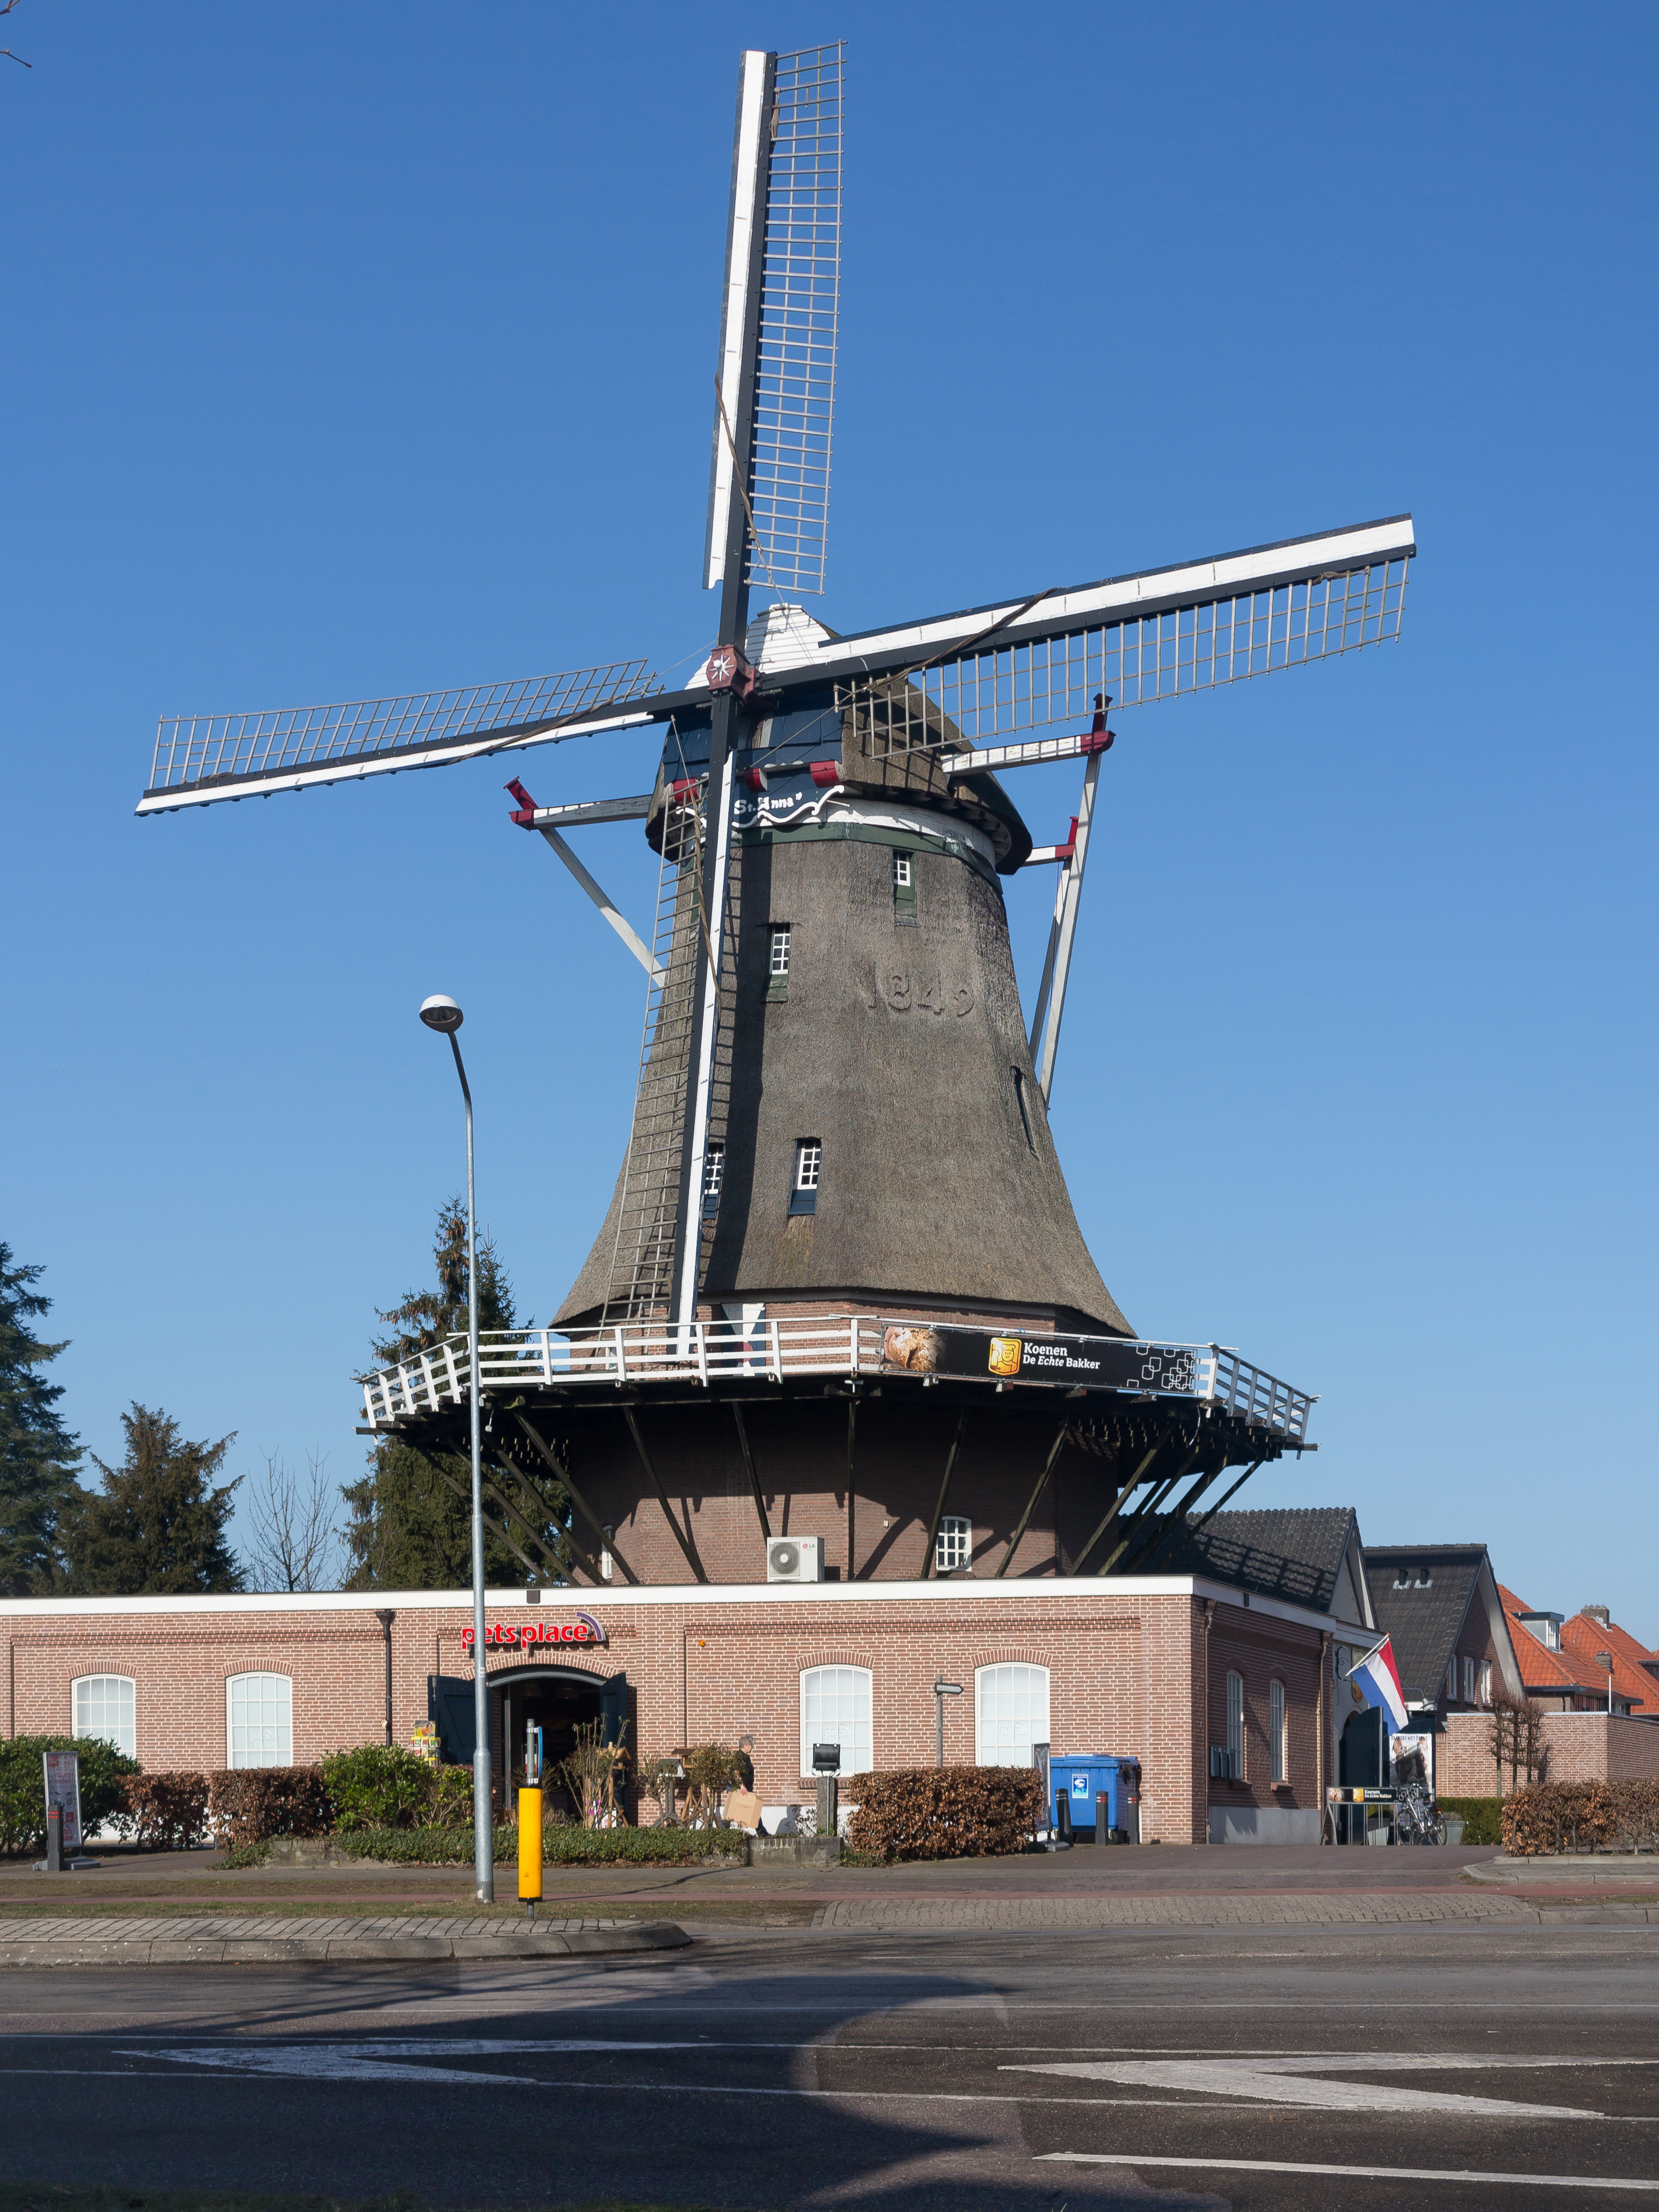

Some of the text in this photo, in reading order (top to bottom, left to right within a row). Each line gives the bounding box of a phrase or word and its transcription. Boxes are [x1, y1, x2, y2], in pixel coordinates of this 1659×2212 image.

[734, 799, 756, 815] St.
[1024, 1342, 1068, 1356] Koenen
[1023, 1354, 1101, 1370] De Echte Bakker
